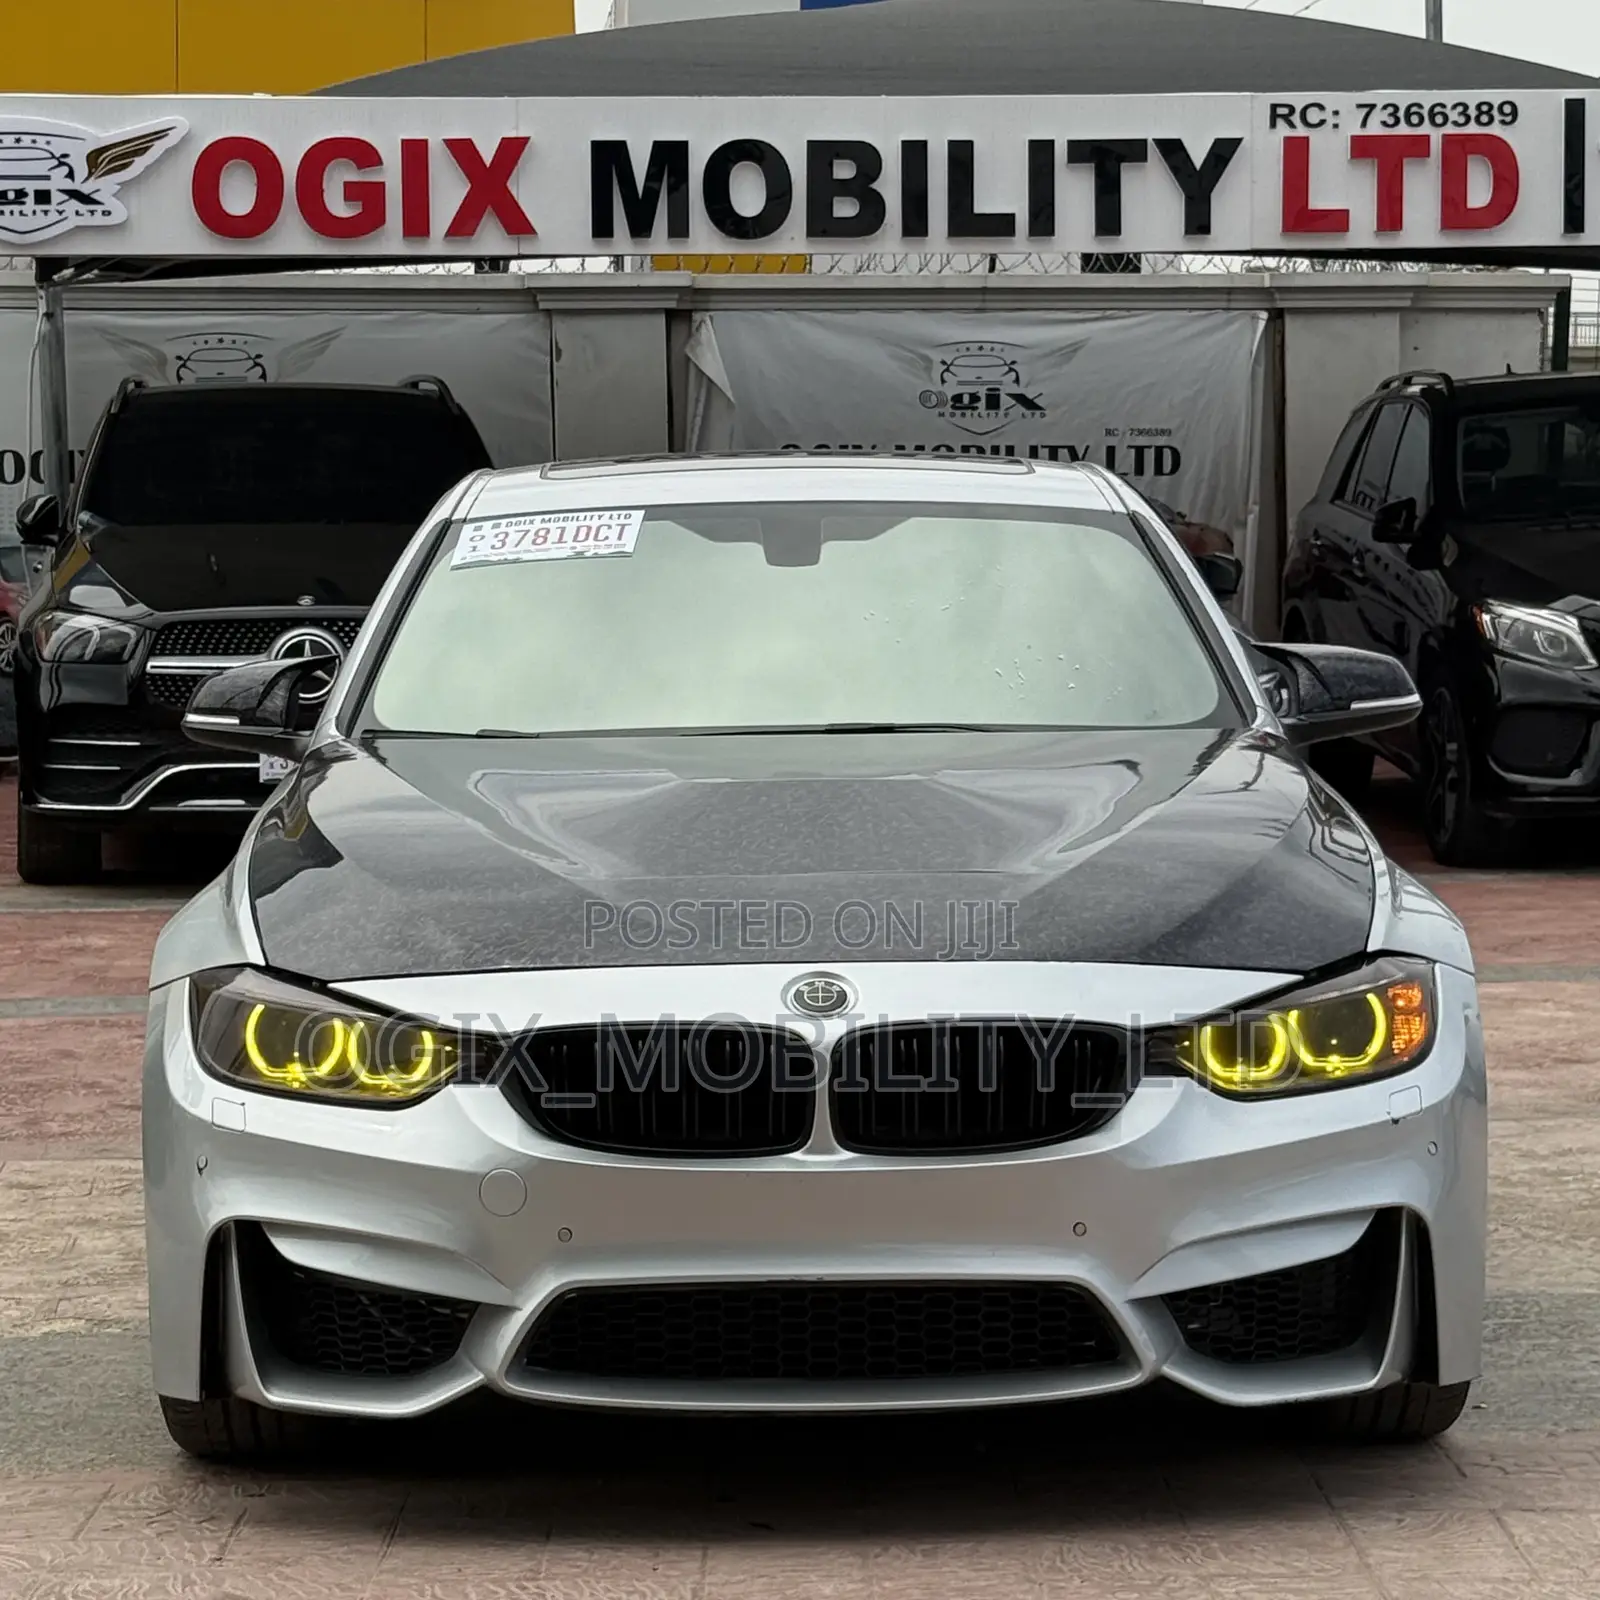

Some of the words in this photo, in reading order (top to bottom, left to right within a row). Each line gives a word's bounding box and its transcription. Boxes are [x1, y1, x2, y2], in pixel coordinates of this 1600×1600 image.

[1269, 102, 1341, 130] RC:
[1355, 100, 1519, 129] 7366389
[192, 136, 538, 239] OGIX
[590, 138, 1244, 240] MOBILITY
[1281, 133, 1520, 233] LTD
[1105, 445, 1182, 477] LTD
[540, 513, 605, 525] MOBILITY
[608, 512, 633, 521] LTD
[490, 523, 632, 550] 3781DCT
